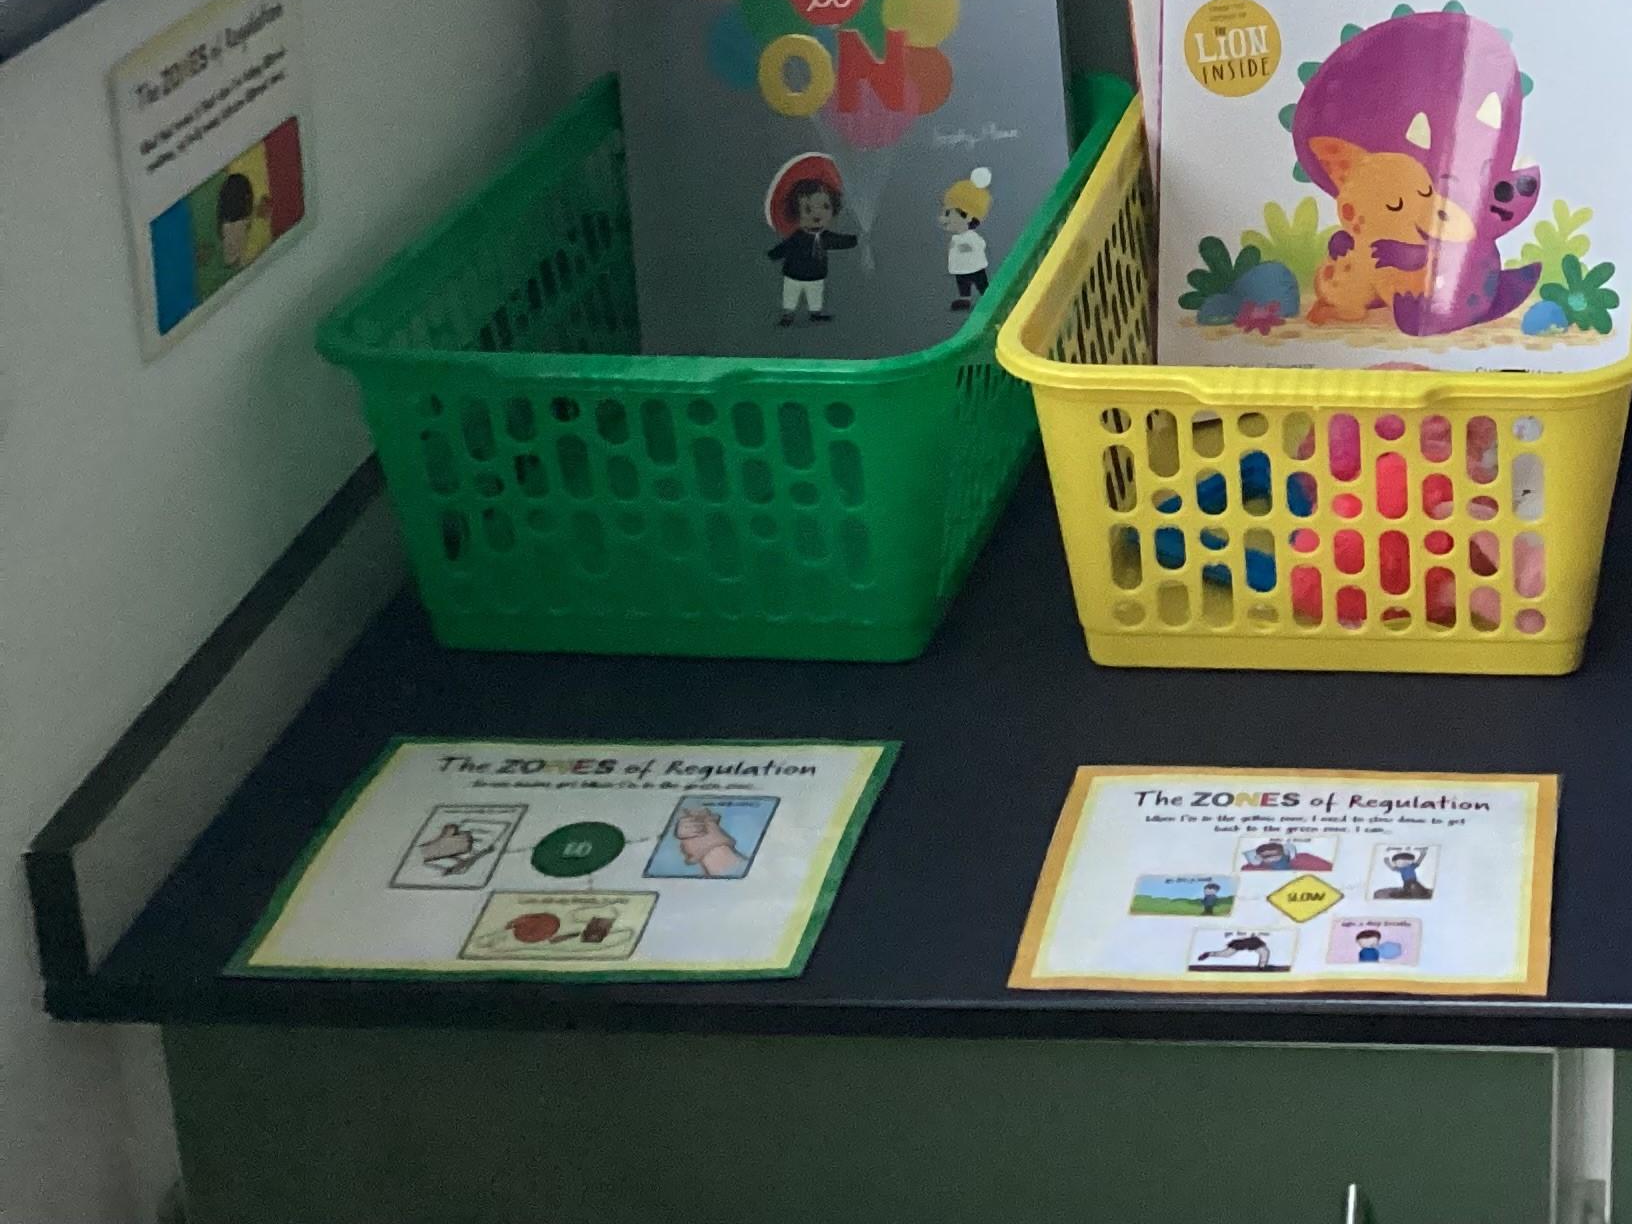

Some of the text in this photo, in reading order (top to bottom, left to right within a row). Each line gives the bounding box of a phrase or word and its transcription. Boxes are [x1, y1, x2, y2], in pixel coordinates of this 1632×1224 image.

[1194, 25, 1269, 63] LION
[758, 29, 909, 117] ON
[1202, 57, 1269, 84] INSIDE
[439, 755, 816, 782] The ZONES of Regulation
[1134, 790, 1490, 815] The ZONES of Regulation
[1287, 891, 1325, 903] SLOW
